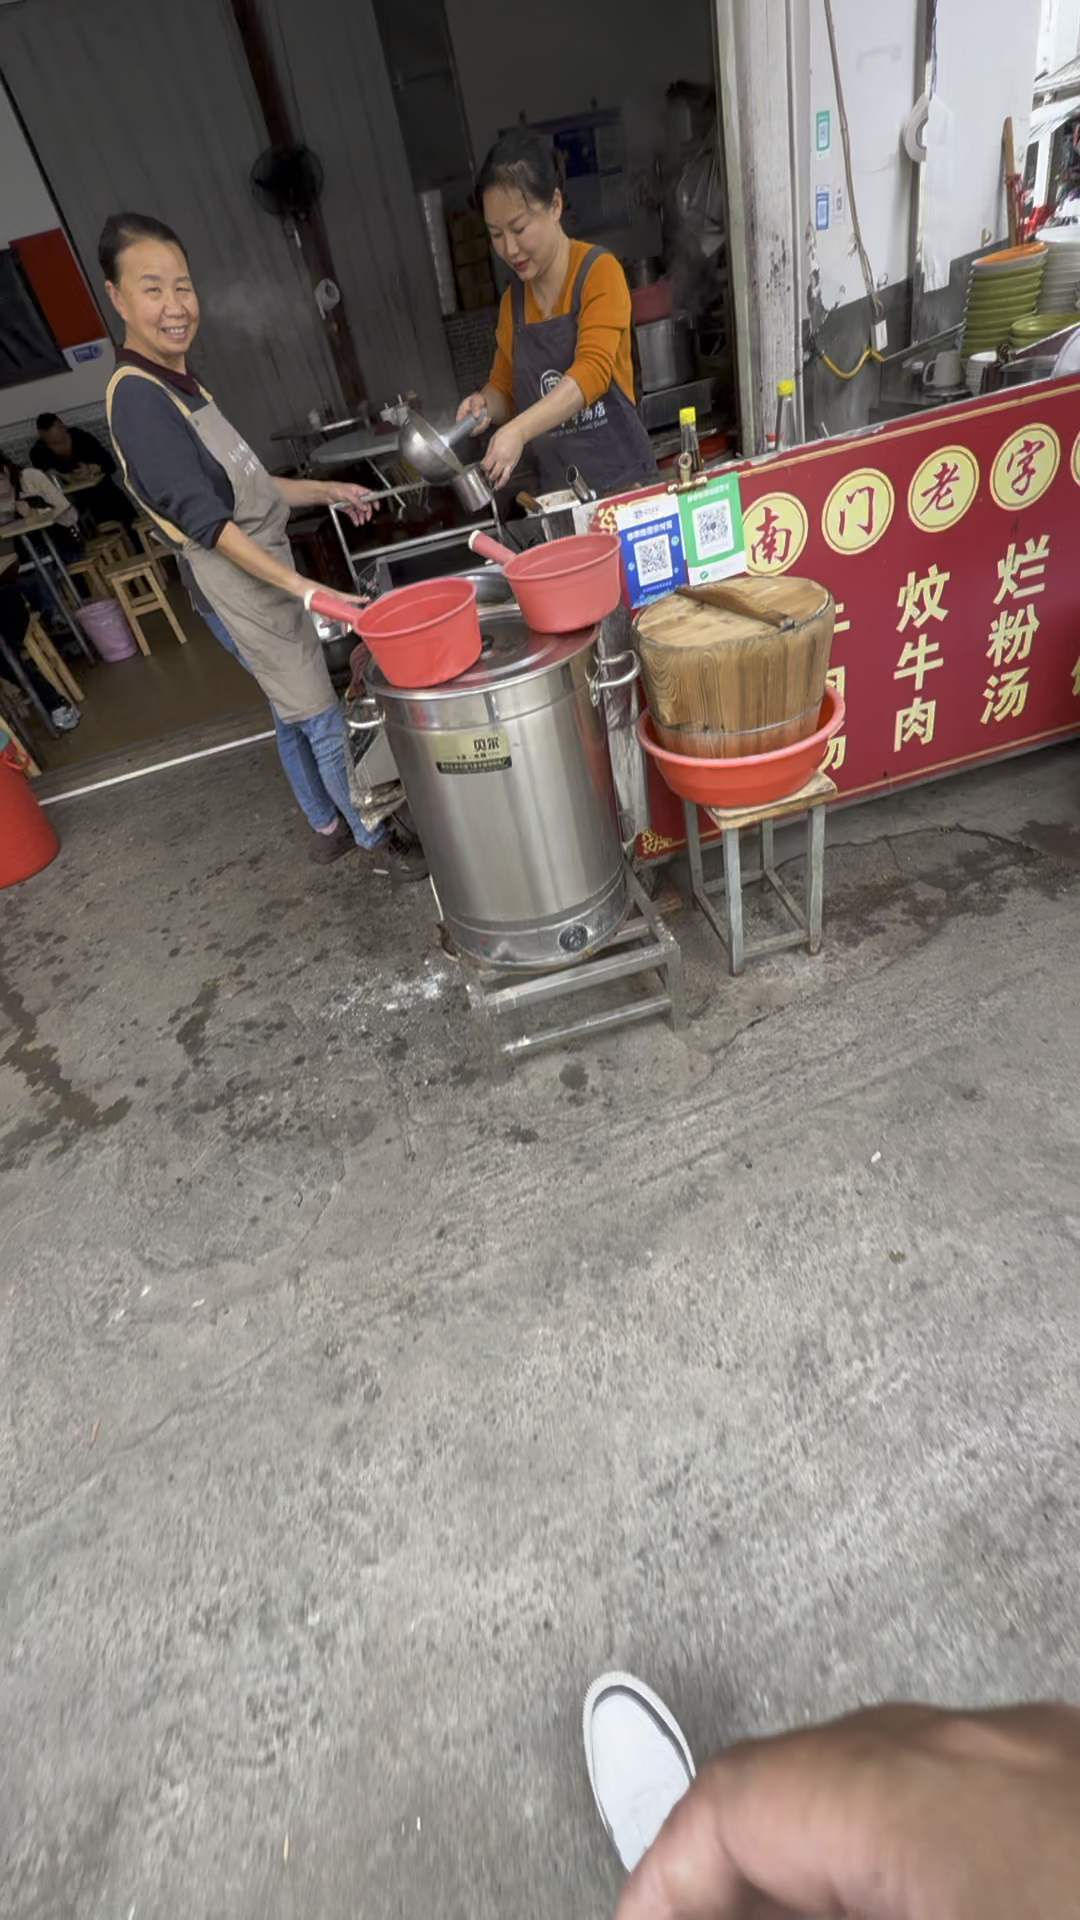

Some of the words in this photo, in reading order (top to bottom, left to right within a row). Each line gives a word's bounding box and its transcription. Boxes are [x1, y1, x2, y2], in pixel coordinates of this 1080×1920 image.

[893, 563, 951, 753] 炆牛肉
[979, 533, 1051, 724] 烂粉汤
